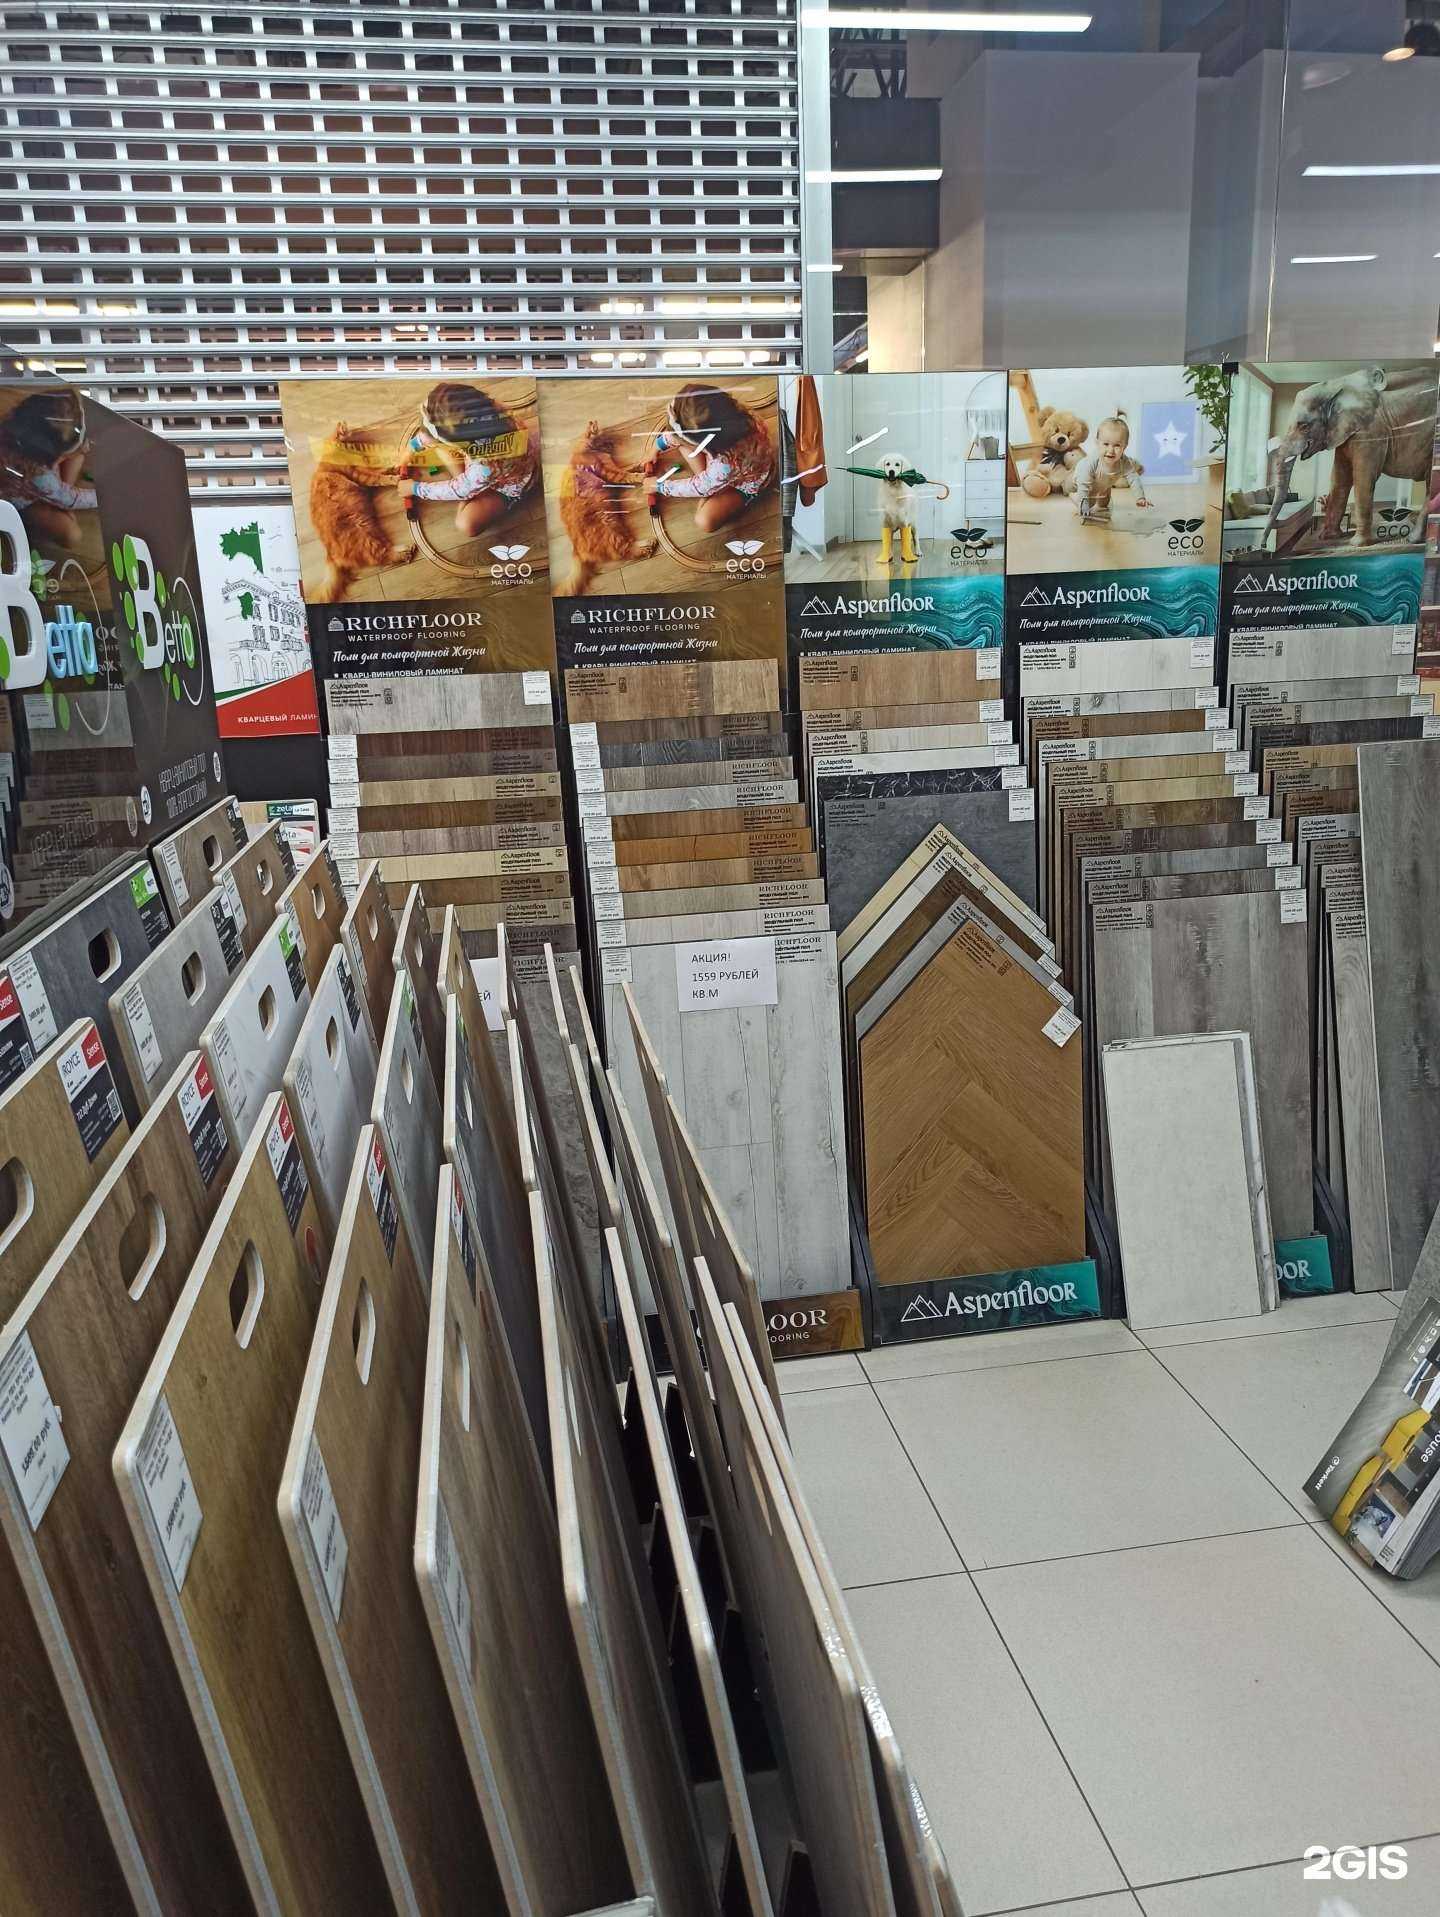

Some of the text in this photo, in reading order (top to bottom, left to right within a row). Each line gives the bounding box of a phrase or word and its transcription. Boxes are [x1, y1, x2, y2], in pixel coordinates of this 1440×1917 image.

[1377, 525, 1410, 538] eco
[1168, 535, 1204, 550] eco
[490, 563, 532, 578] eco
[725, 557, 766, 573] eco
[588, 606, 716, 623] RICHFLOOR
[1254, 606, 1270, 618] для
[1271, 601, 1328, 615] комфортной
[1330, 600, 1358, 613] Жизни
[346, 612, 482, 631] RICHFLOOR
[589, 623, 700, 634] WATERPROOF FLOORING
[1043, 621, 1059, 632] для
[1061, 616, 1120, 630] комфортной
[1122, 614, 1152, 626] Жизни
[348, 630, 466, 642] WATERPROOF FLOORING
[825, 630, 842, 641] для
[843, 626, 904, 640] комфортной
[906, 623, 937, 635] Жизни
[600, 645, 618, 655] для
[619, 640, 684, 654] комфортной
[686, 637, 718, 650] Жизни
[360, 653, 379, 665] для
[380, 648, 450, 664] комфортной
[452, 646, 486, 660] Жизни
[238, 714, 288, 724] КВАРЦЕВЫЙ
[774, 937, 821, 946] ICHFLOOR
[691, 953, 731, 965] АКЦИЯ!
[692, 968, 759, 983] 1559 РУБЛЕЙ
[692, 988, 719, 999] КВ.М
[62, 1042, 100, 1076] ROYCE Sense
[767, 1309, 829, 1331] OOR
